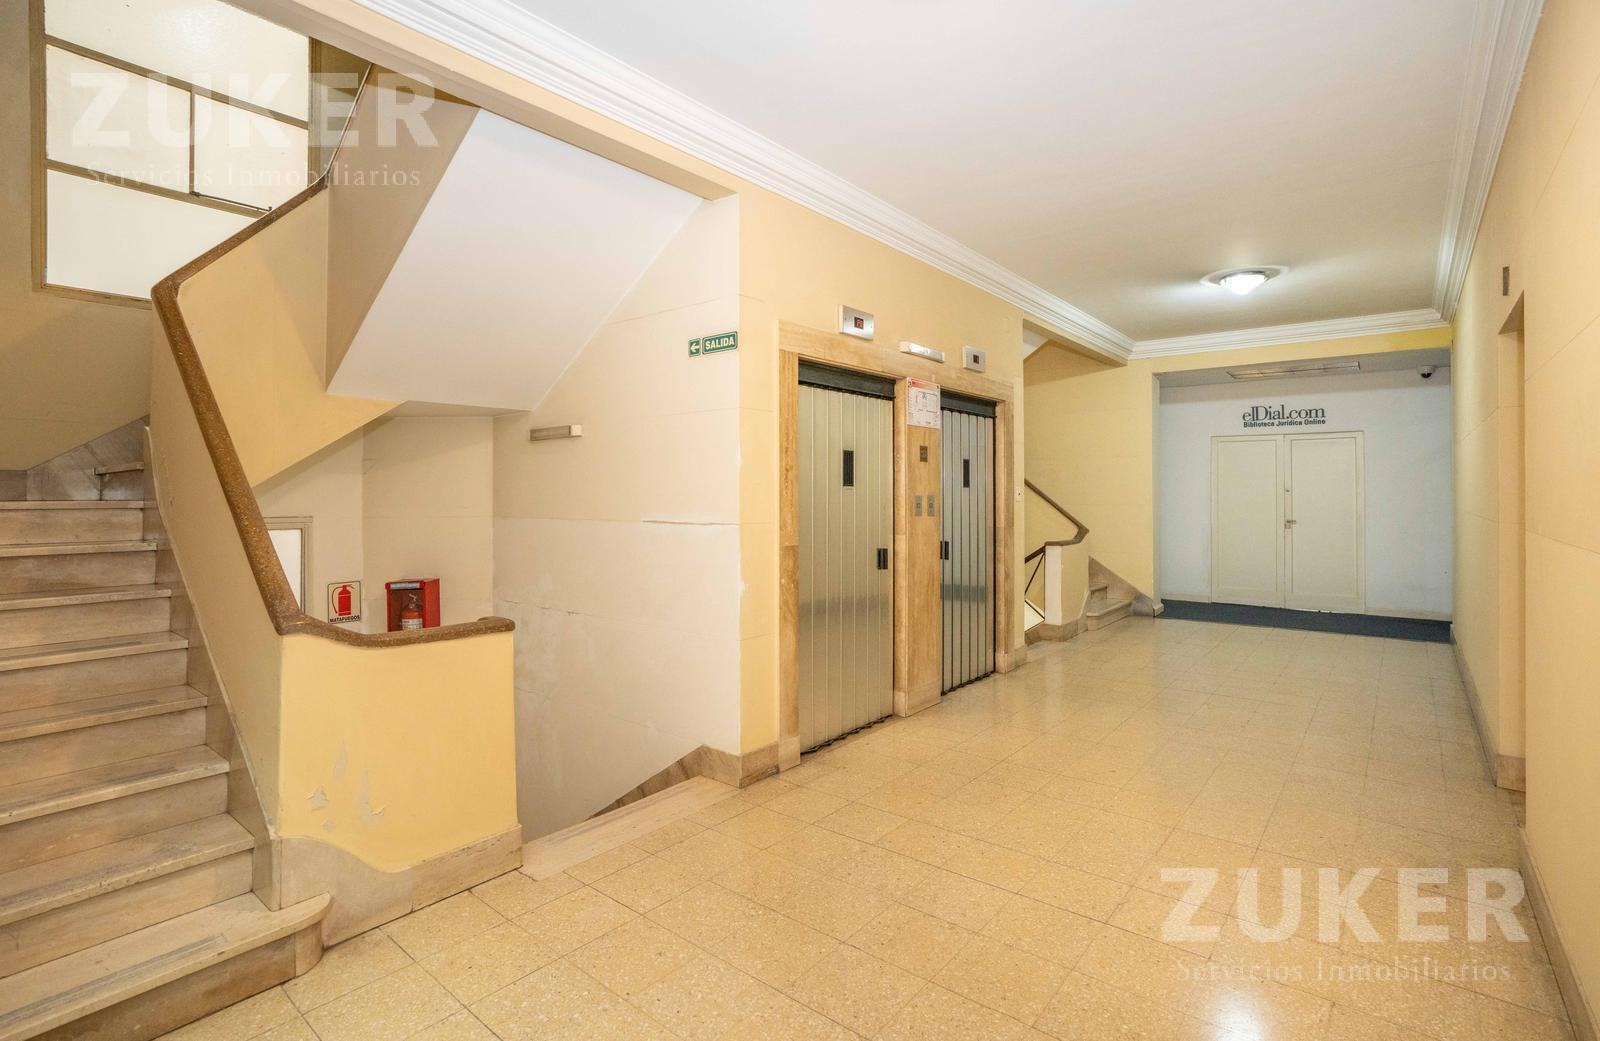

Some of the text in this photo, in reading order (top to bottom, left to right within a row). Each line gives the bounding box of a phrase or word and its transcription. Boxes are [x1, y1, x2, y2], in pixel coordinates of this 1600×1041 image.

[705, 336, 735, 350] SALIDA
[1242, 404, 1326, 421] elDial.com
[1276, 419, 1303, 427] Jurídica
[1304, 418, 1326, 426] Online
